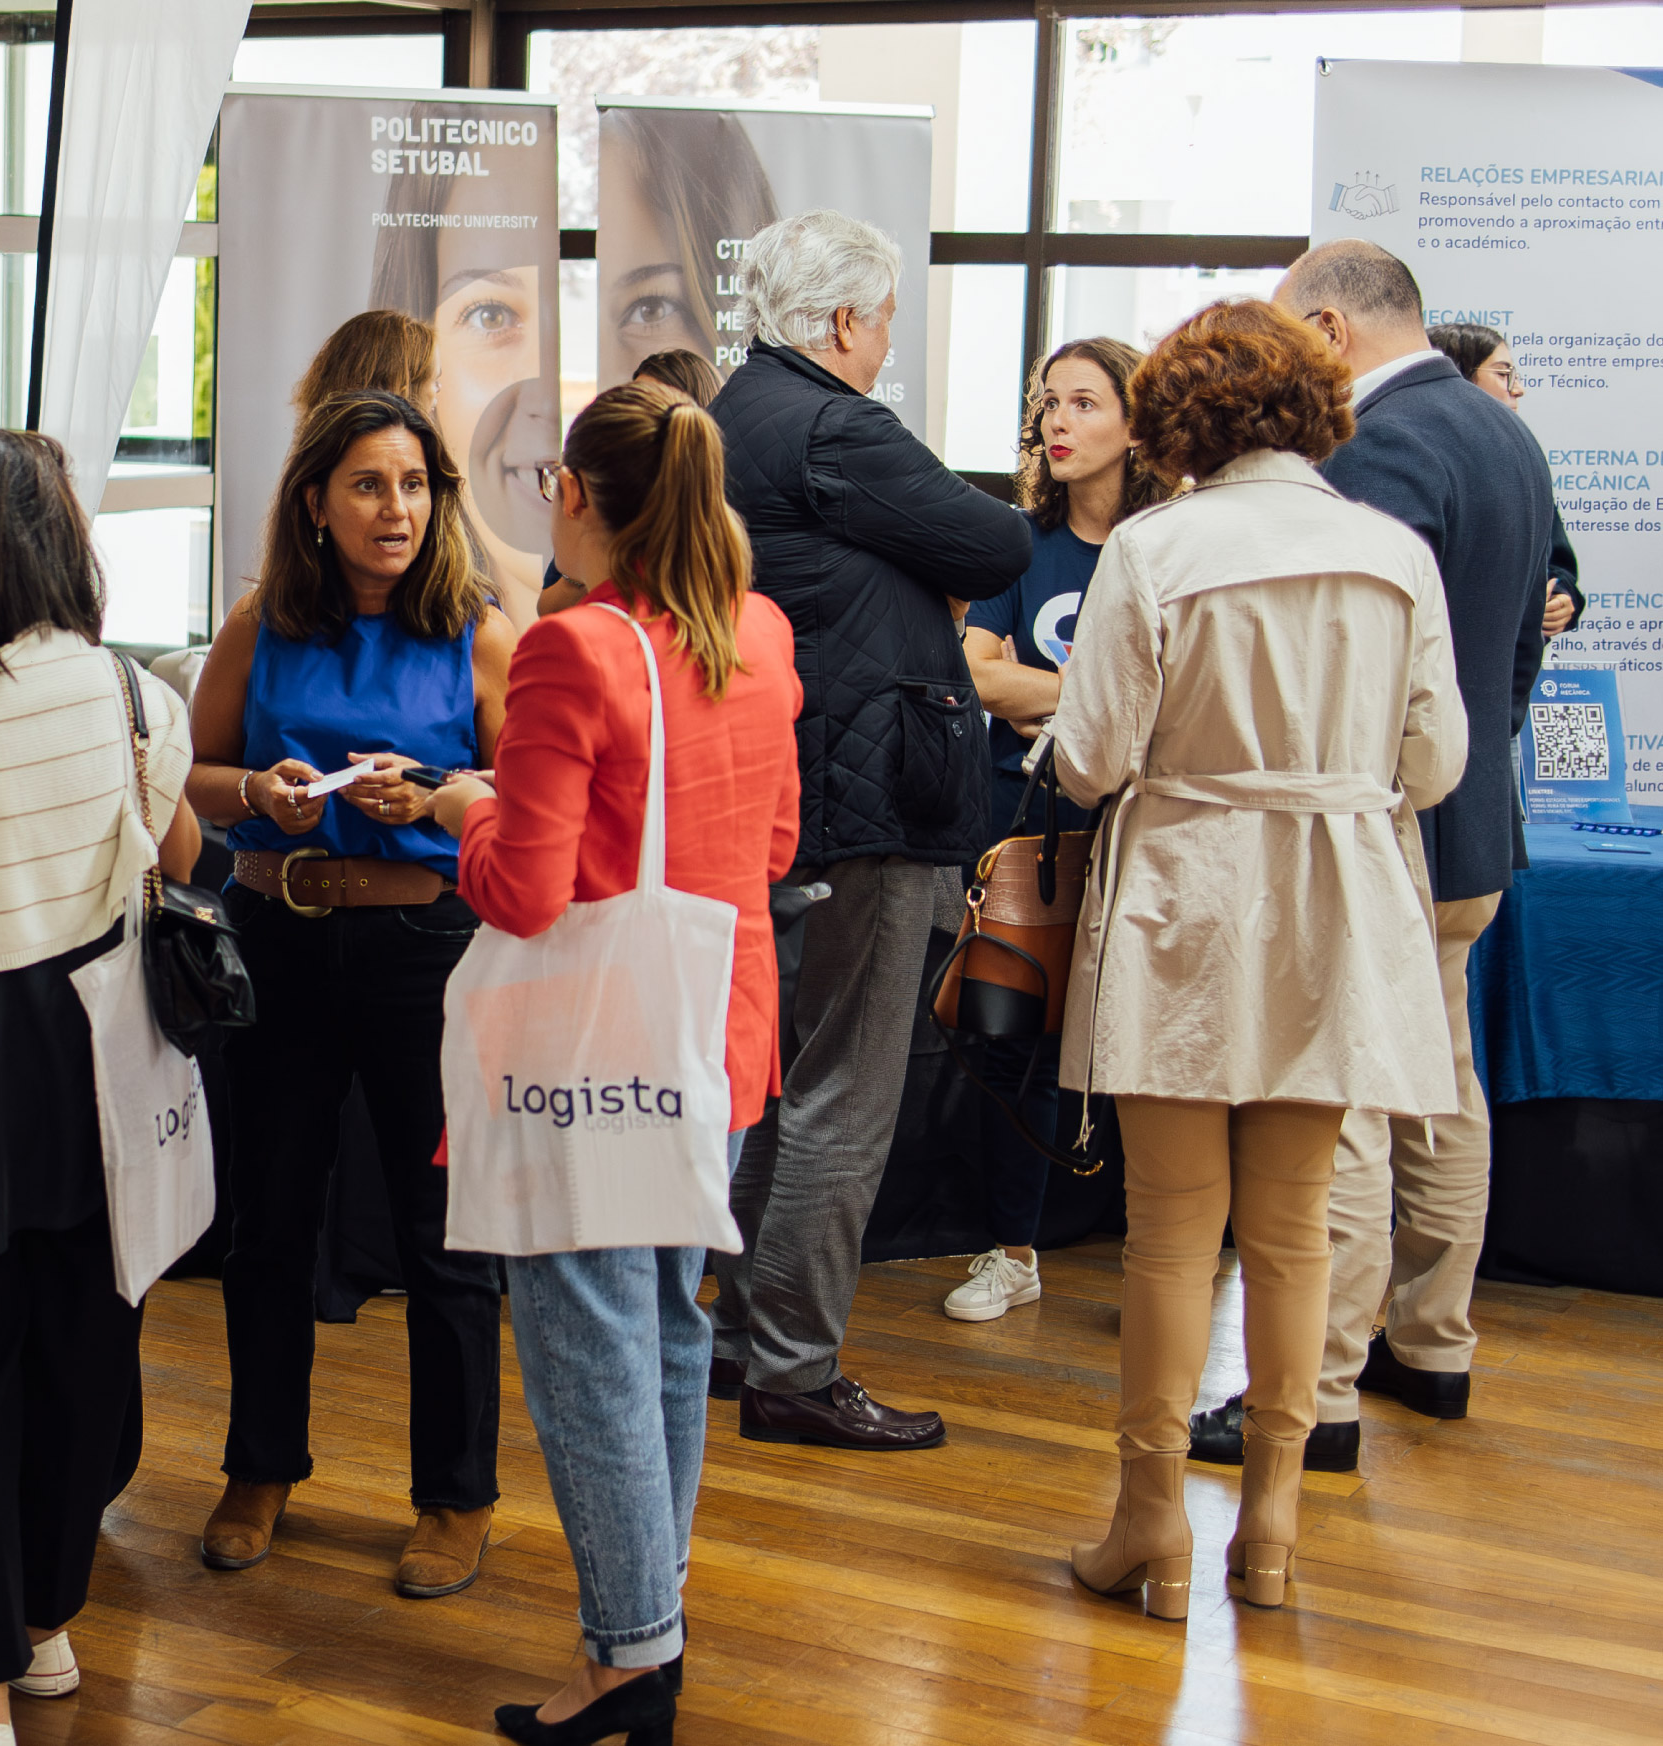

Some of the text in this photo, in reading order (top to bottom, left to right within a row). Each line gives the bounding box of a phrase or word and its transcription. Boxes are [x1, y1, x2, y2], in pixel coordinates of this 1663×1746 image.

[1420, 164, 1524, 187] RELAÇÕES
[1419, 191, 1661, 210] Responsável pelo contacto com
[372, 212, 539, 229] POLYTECHNIC UNIVERSITY
[1418, 214, 1515, 230] promovendo
[1520, 218, 1528, 228] a
[1533, 216, 1631, 233] aproximação
[1417, 235, 1530, 250] e o académico.
[1512, 332, 1544, 348] pela
[1549, 332, 1641, 349] organização
[1518, 353, 1563, 367] direto
[1568, 355, 1607, 367] entre
[1548, 374, 1609, 388] Técnico.
[869, 382, 905, 402] AIS
[1548, 450, 1663, 466] EXTERNA D
[1632, 497, 1651, 511] de
[1634, 518, 1661, 532] dos
[1584, 588, 1663, 609] PETÊNC
[1626, 619, 1635, 630] e
[1592, 637, 1647, 651] através
[1652, 638, 1663, 651] d
[1632, 758, 1651, 771] de
[503, 1074, 682, 1129] logista
